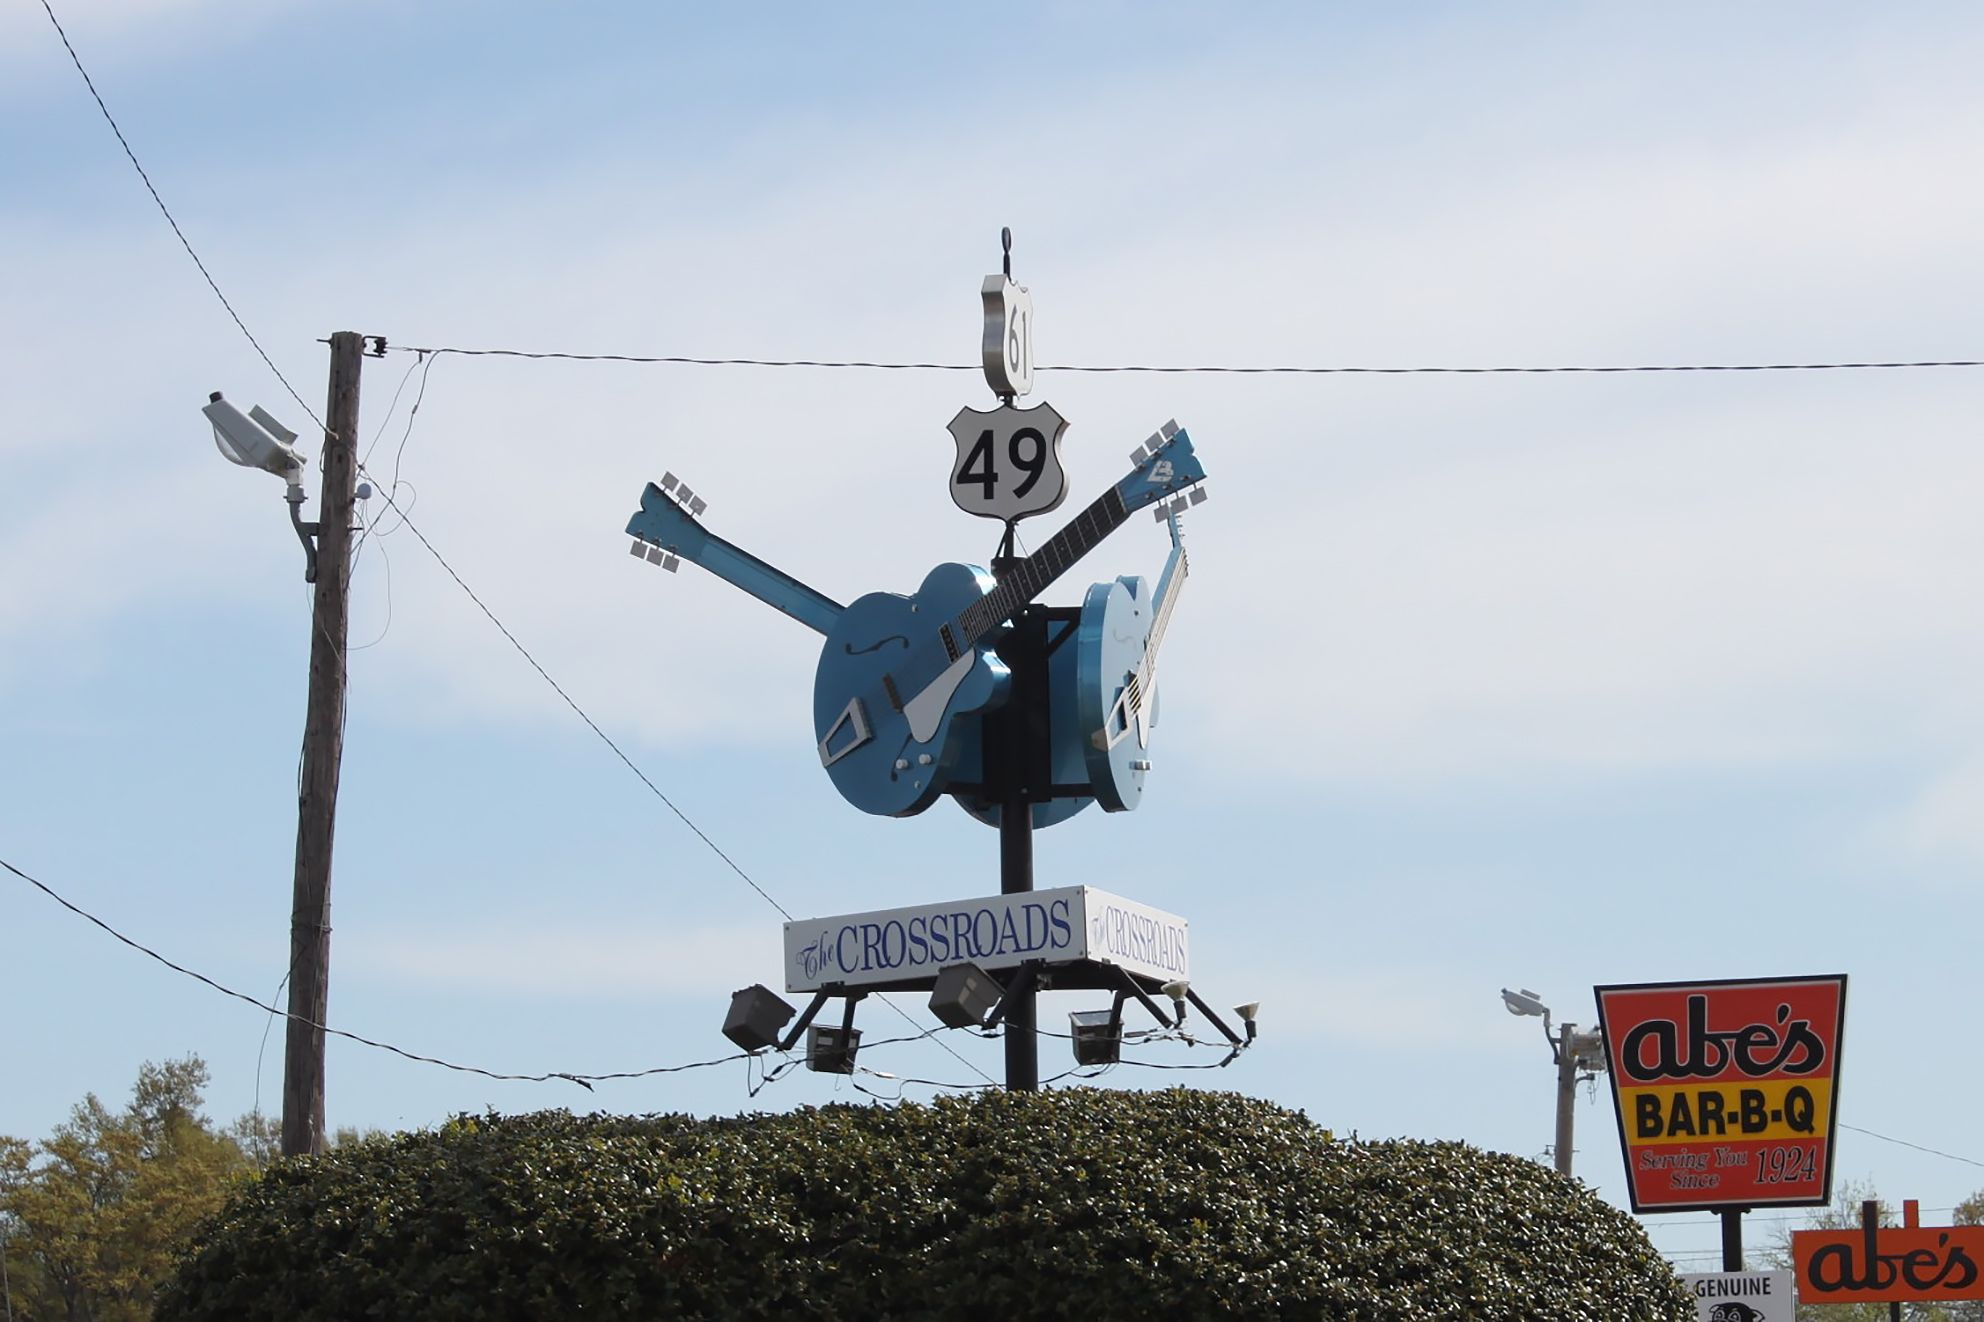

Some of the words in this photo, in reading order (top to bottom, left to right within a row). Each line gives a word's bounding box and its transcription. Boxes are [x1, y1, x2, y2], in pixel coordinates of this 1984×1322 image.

[1009, 304, 1027, 379] 61
[956, 427, 1047, 500] 49
[797, 931, 835, 980] The
[836, 899, 1072, 974] CROSSROADS
[1106, 905, 1185, 975] CROSSROADS
[1622, 994, 1824, 1081] abe's
[1640, 1150, 1710, 1171] Serving
[1714, 1147, 1748, 1168] You
[1670, 1170, 1720, 1190] Since
[1753, 1146, 1816, 1184] 1924
[1808, 1200, 1978, 1292] abe's
[1696, 1277, 1771, 1297] GENUINE
